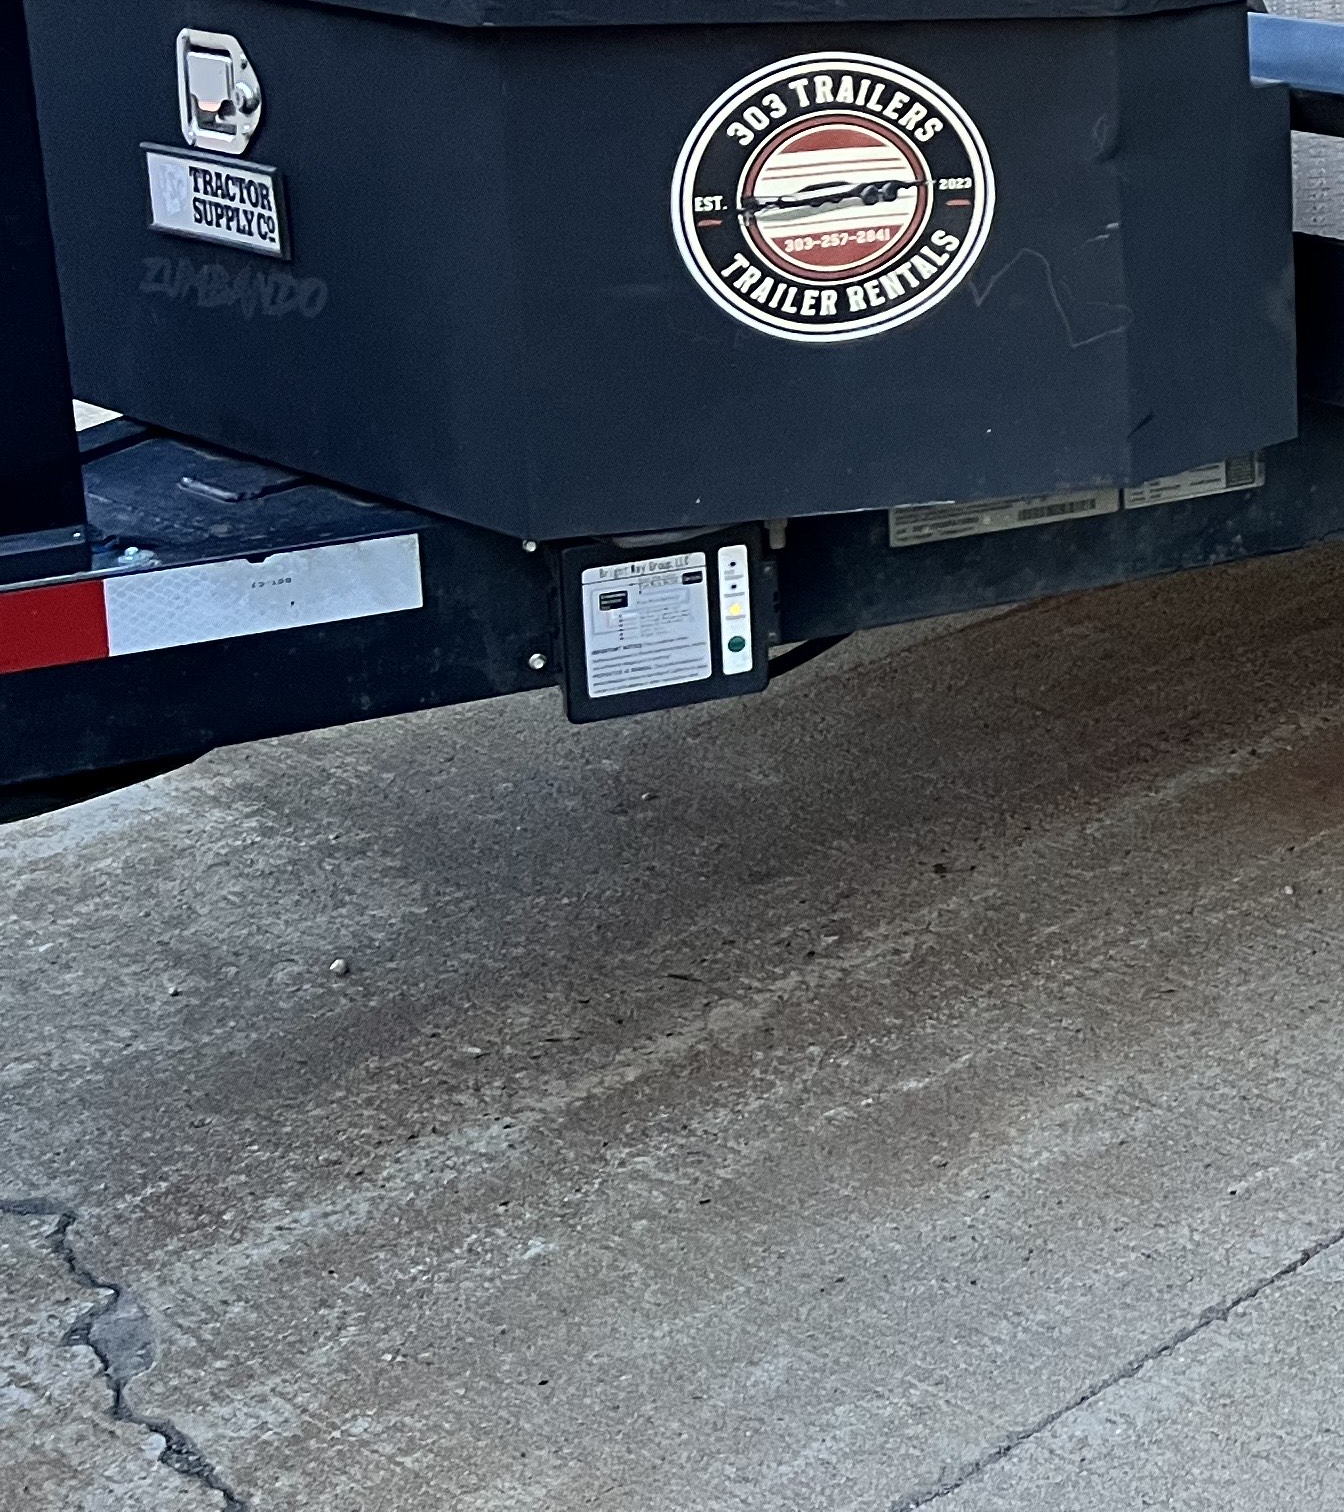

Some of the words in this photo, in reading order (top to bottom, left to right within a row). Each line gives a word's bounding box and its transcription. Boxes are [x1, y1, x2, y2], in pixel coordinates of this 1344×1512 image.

[726, 93, 788, 146] 303
[788, 75, 944, 143] TRAILERS
[188, 165, 273, 212] TRACTOR
[694, 196, 728, 212] EST.
[938, 177, 972, 190] 2023
[192, 196, 255, 237] SUPPLY
[784, 228, 891, 253] 303-257-2841
[721, 252, 838, 317] TRAILER
[846, 229, 961, 312] RENTALS
